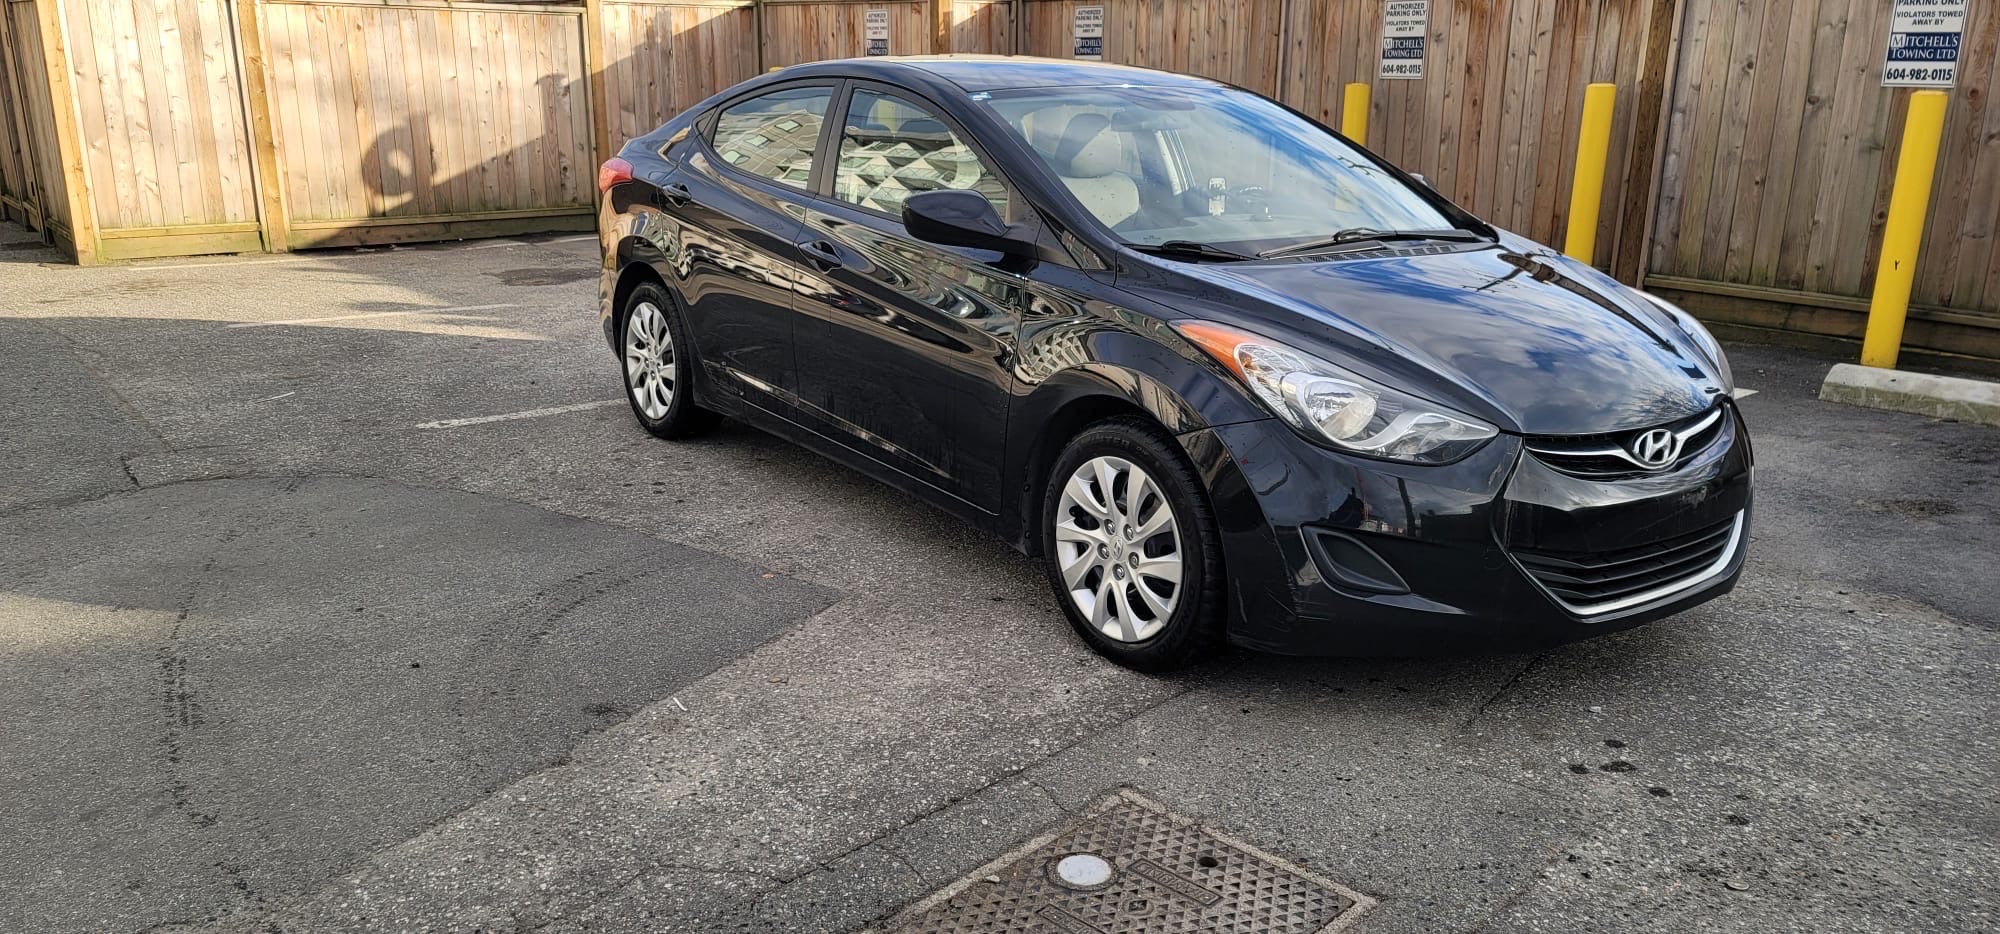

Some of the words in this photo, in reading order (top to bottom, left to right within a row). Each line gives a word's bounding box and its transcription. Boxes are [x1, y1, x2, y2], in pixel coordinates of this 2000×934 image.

[1891, 33, 1959, 48] MITCHELL'S
[1892, 48, 1935, 59] TOWING
[1936, 48, 1956, 59] LTD
[1886, 67, 1953, 81] 604-982-0115
